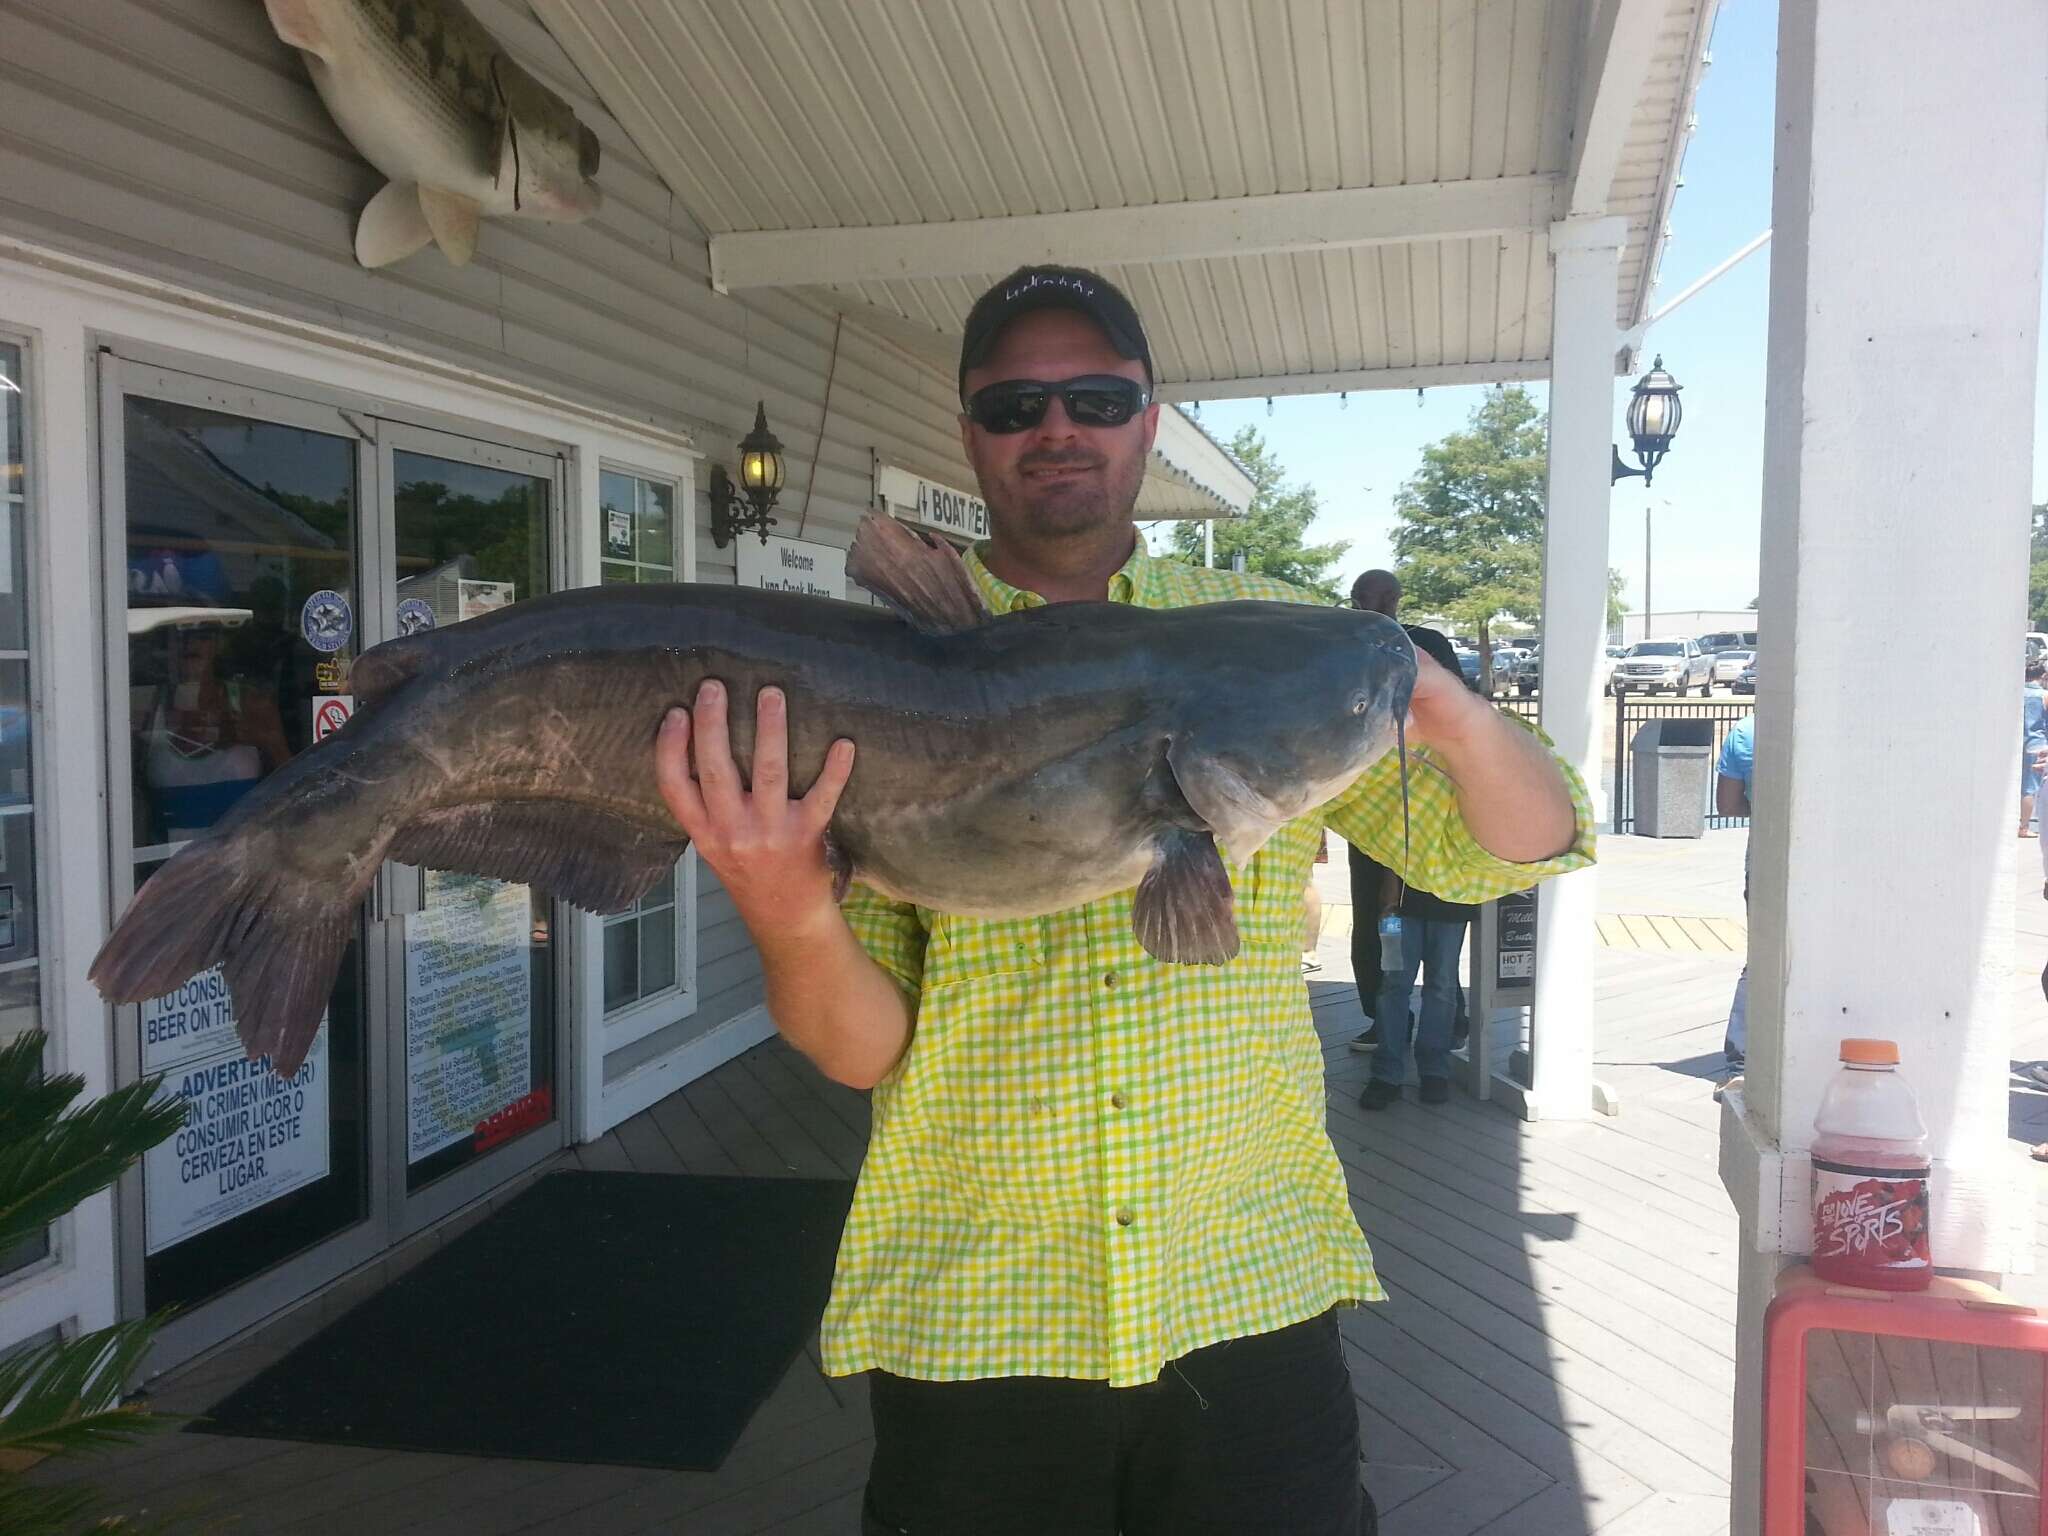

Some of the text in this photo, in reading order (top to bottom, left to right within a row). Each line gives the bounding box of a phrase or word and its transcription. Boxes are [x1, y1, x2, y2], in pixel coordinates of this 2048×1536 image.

[932, 488, 966, 529] BOAT
[780, 546, 814, 572] Welcome
[1503, 954, 1523, 965] HOT
[147, 1012, 187, 1045] BEER
[190, 1002, 211, 1033] ON
[206, 1080, 259, 1121] CRIMEN
[176, 1090, 304, 1158] CONSUMIR LICOR O
[181, 1115, 300, 1184] CERVEZA EN ESTE
[218, 1155, 269, 1196] LUGAR.
[1822, 1199, 1908, 1257] SPORTS
[1834, 1190, 1875, 1229] LOVE
